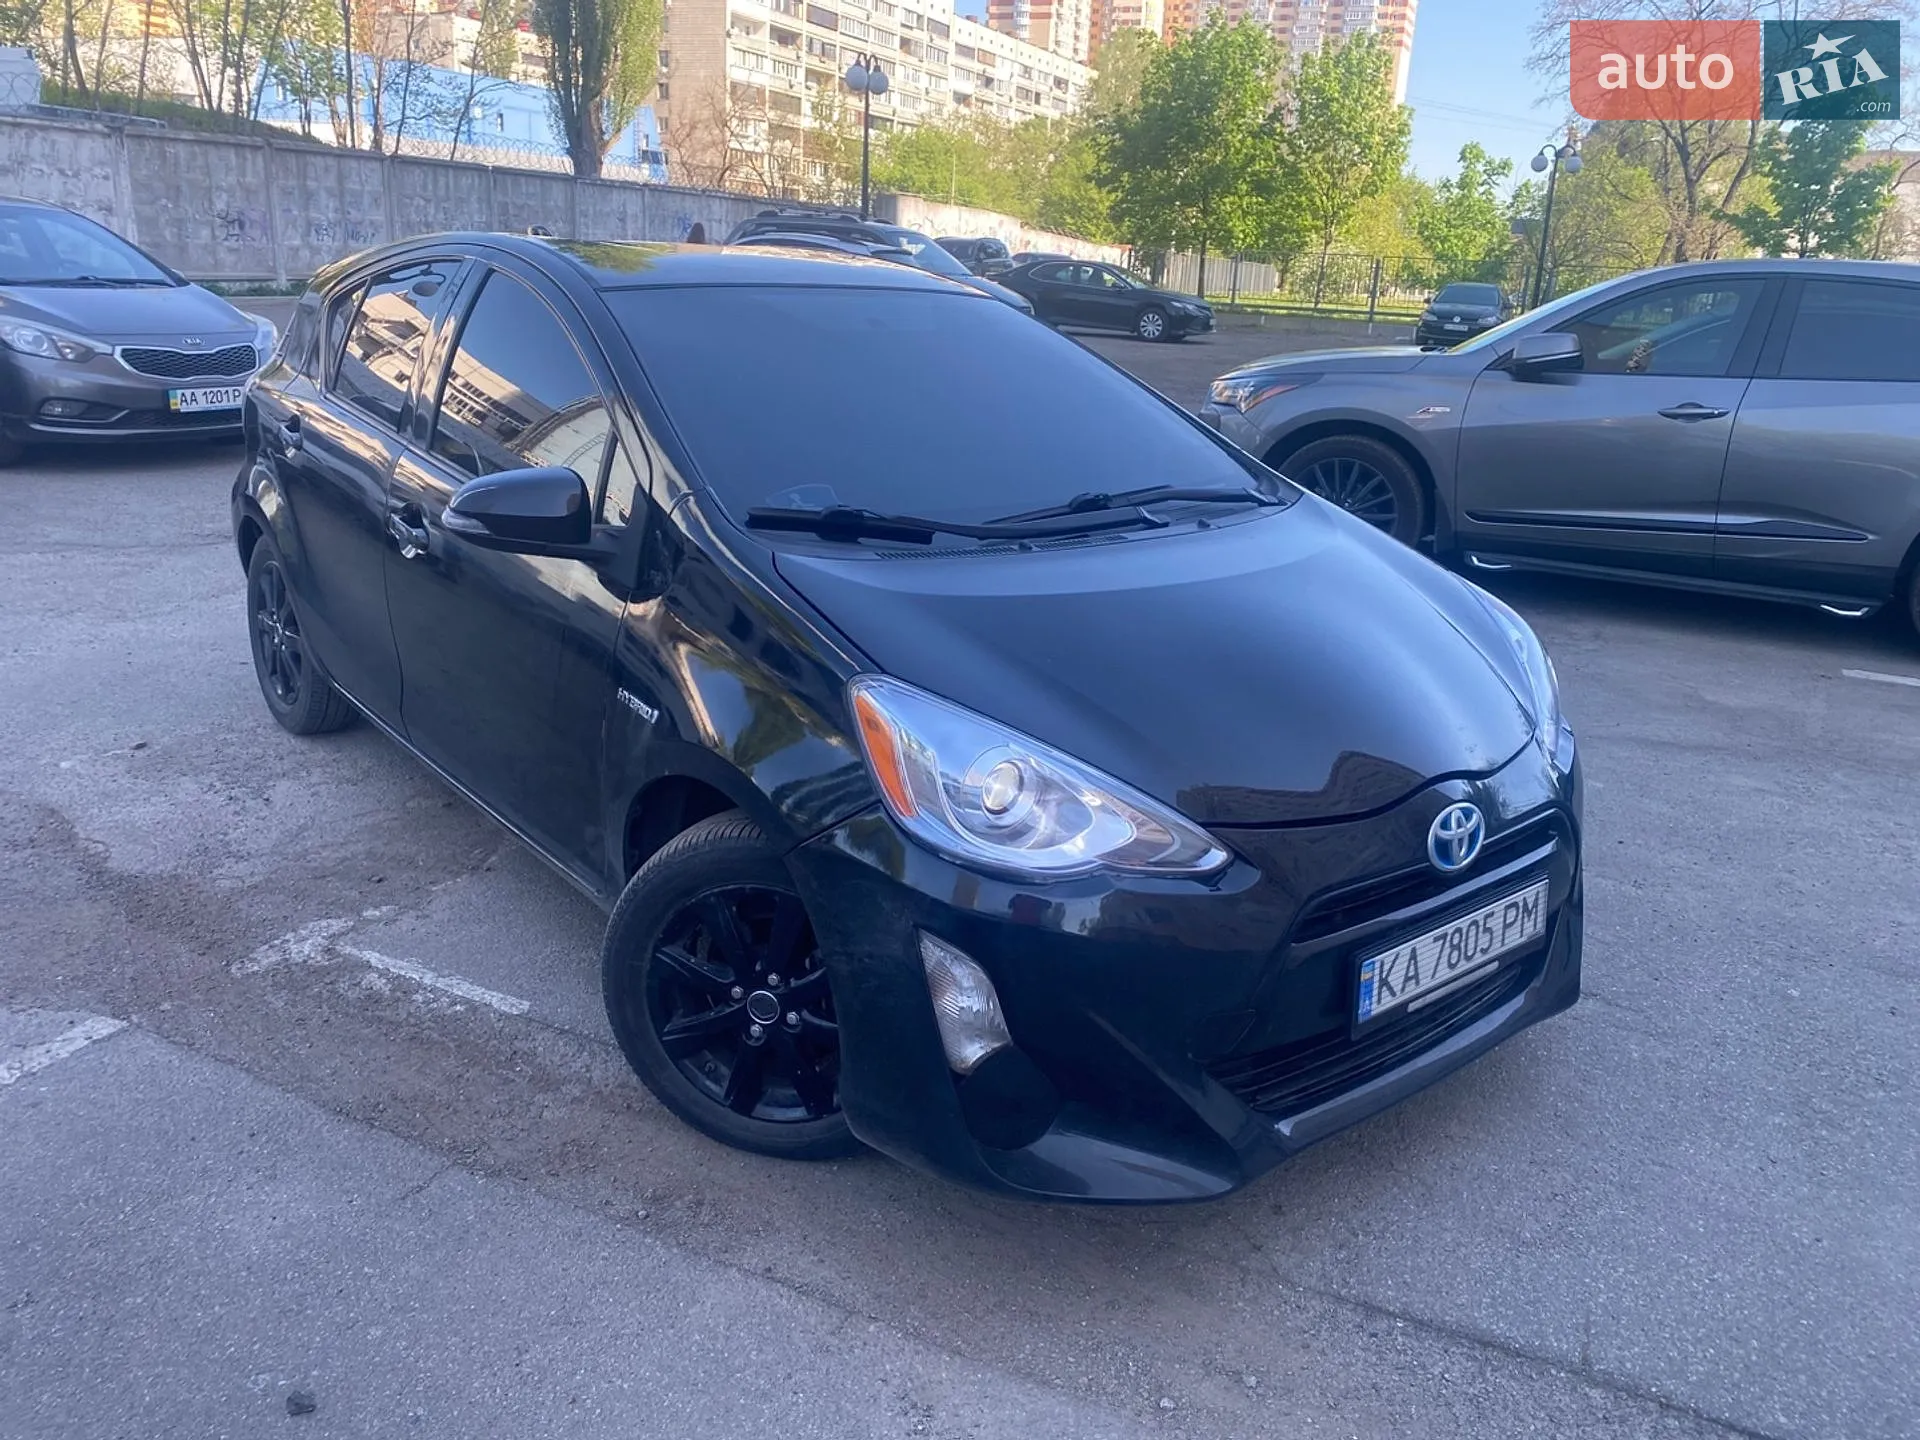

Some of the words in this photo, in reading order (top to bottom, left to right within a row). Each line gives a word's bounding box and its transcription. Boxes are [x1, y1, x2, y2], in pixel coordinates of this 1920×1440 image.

[180, 391, 199, 406] AA
[202, 389, 231, 405] 1201
[1376, 946, 1421, 1006] KA
[1430, 911, 1496, 980] 7805
[1500, 890, 1540, 948] PM
